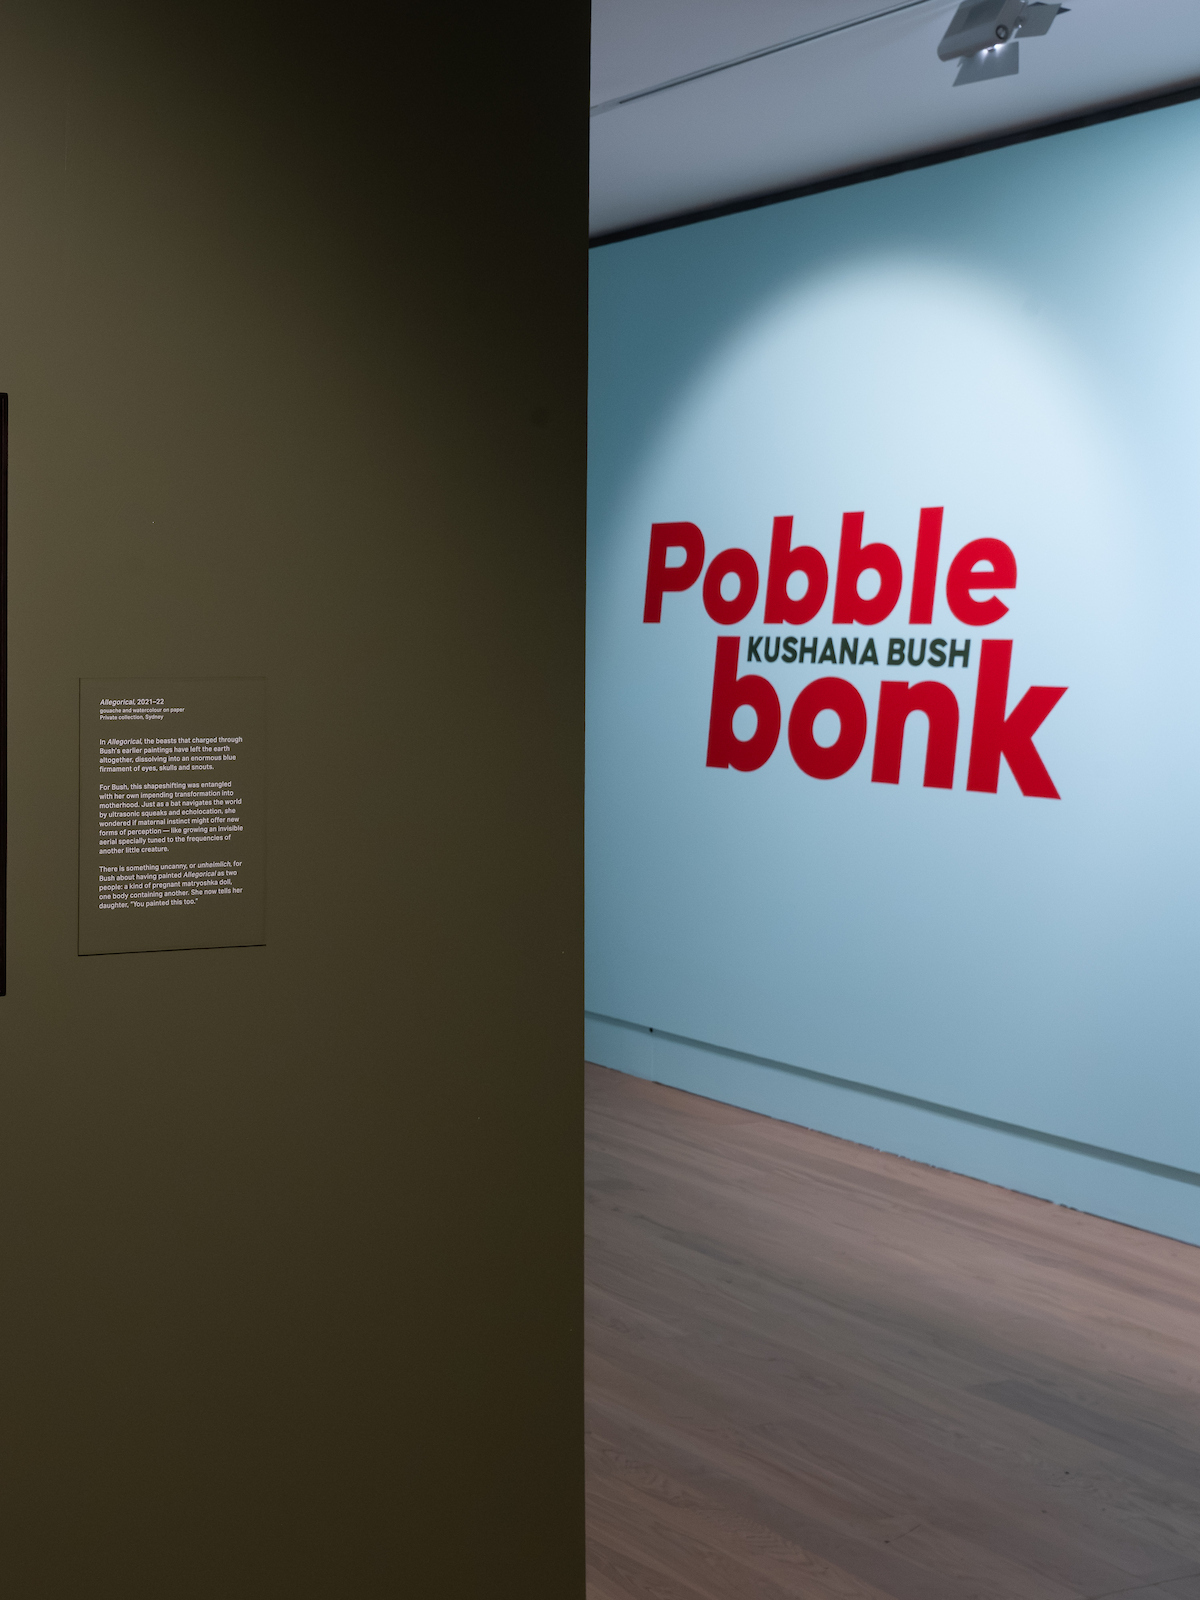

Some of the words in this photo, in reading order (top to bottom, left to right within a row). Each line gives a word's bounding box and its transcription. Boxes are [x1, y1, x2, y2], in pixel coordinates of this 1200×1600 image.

[643, 506, 1017, 626] Pobble
[747, 636, 879, 666] KUSHANA
[886, 637, 971, 668] BUSH
[145, 713, 164, 721] Sydney
[705, 636, 1069, 801] bonk
[143, 737, 155, 745] the
[155, 737, 177, 745] beasts
[191, 736, 218, 745] charged
[218, 736, 243, 744] through
[143, 746, 173, 755] paintings
[189, 745, 201, 753] left
[202, 745, 213, 753] the
[134, 755, 167, 764] dissolving
[99, 765, 132, 773] firmament
[99, 783, 111, 791] For
[143, 781, 187, 791] shapeshifting
[200, 780, 232, 789] entangled
[114, 792, 125, 800] her
[140, 791, 174, 800] impending
[174, 789, 221, 798] transformation
[221, 789, 234, 797] into
[181, 799, 212, 808] navigates
[213, 798, 224, 806] the
[99, 811, 108, 820] by
[108, 810, 140, 818] ultrasonic
[141, 809, 168, 818] squeaks
[98, 819, 131, 827] wondered
[137, 818, 166, 826] maternal
[166, 817, 190, 825] instinct
[191, 817, 209, 826] might
[210, 816, 226, 824] offer
[99, 829, 118, 837] forms
[119, 828, 127, 836] of
[127, 827, 162, 836] perception
[182, 826, 208, 835] growing
[217, 824, 244, 832] invisible
[99, 838, 118, 846] aerial
[118, 837, 147, 846] specially
[147, 836, 166, 844] tuned
[174, 835, 186, 843] the
[186, 834, 224, 843] frequencies
[224, 833, 232, 841] of
[99, 847, 124, 855] another
[125, 846, 140, 854] little
[99, 865, 118, 873] There
[126, 863, 160, 873] something
[99, 874, 116, 882] Bush
[135, 872, 157, 882] having
[158, 872, 182, 880] painted
[182, 870, 217, 879] Allegorical
[129, 882, 143, 890] kind
[144, 881, 151, 889] of
[152, 881, 181, 890] pregnant
[181, 879, 218, 888] matryoshka
[112, 892, 129, 901] body
[129, 890, 163, 900] containing
[190, 888, 203, 896] She
[218, 887, 232, 895] tells
[232, 886, 243, 894] her
[145, 899, 170, 908] painted
[170, 898, 183, 906] this
